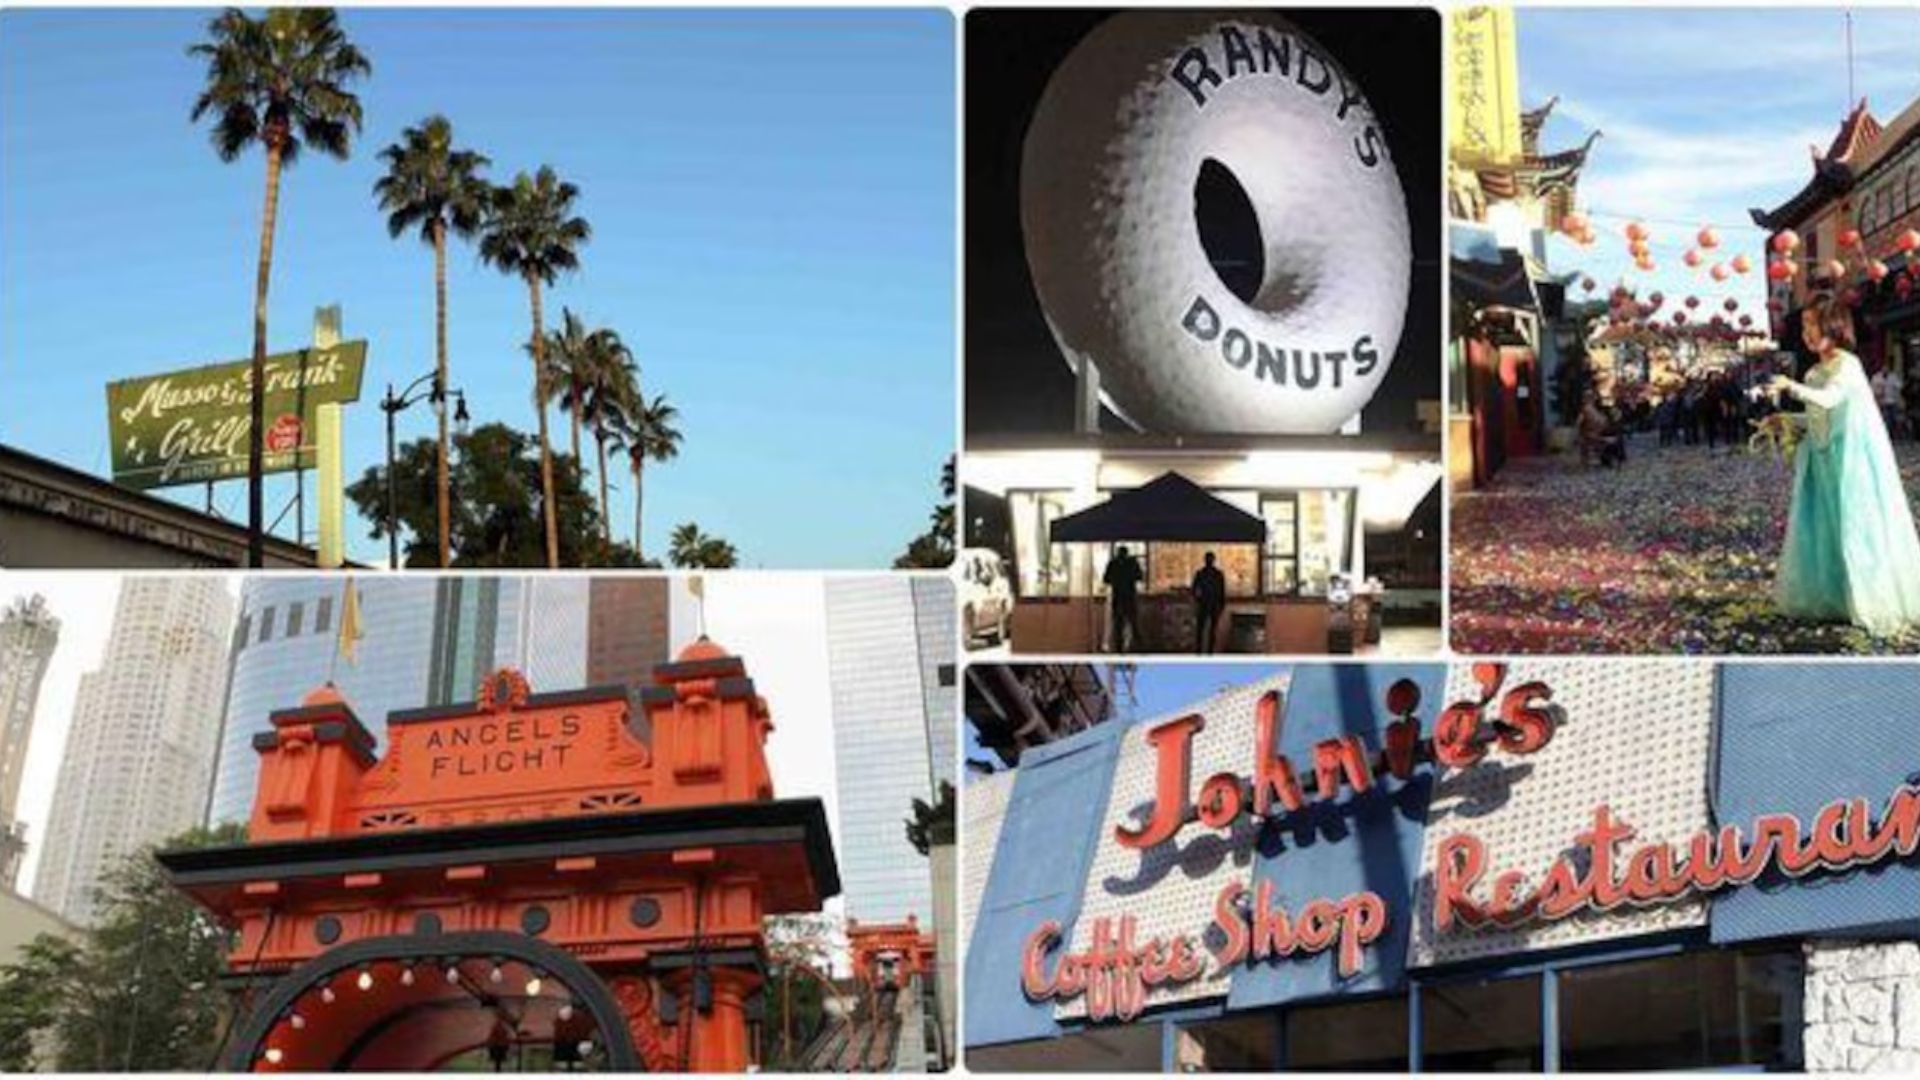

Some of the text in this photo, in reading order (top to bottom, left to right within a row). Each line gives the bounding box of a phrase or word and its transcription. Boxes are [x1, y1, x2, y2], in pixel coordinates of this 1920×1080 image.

[1181, 295, 1378, 389] DONUTS
[120, 377, 217, 425] Musso
[158, 416, 253, 483] Grill
[1115, 663, 1555, 848] Johnie's
[1021, 914, 1203, 1023] Coffee
[1209, 879, 1386, 978] Shop
